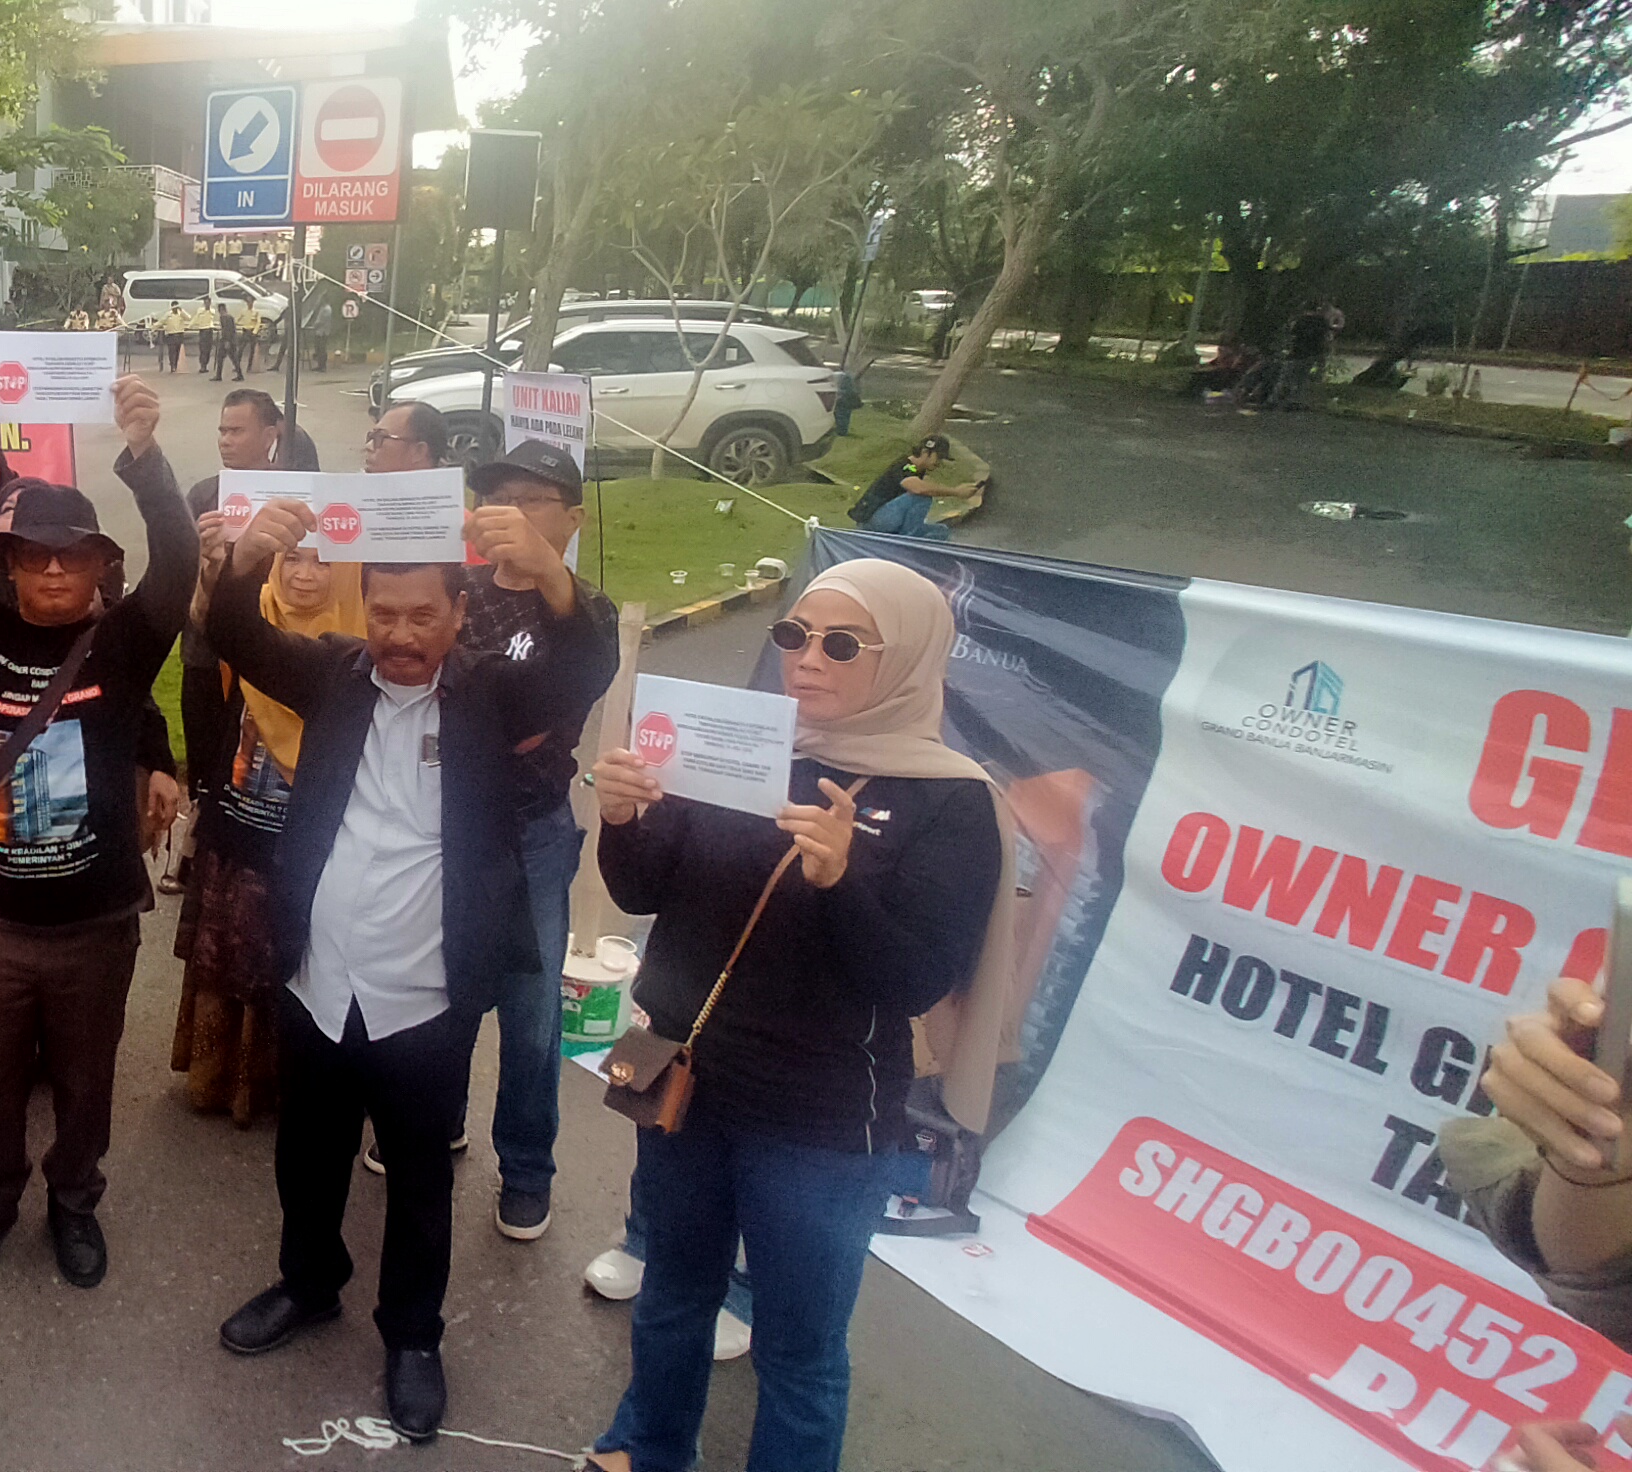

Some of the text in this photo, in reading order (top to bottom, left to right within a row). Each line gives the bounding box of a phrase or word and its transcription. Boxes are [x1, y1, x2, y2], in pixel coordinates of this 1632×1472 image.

[237, 190, 255, 208] IN
[302, 180, 389, 199] DILARANG
[314, 200, 374, 217] MASUK
[512, 385, 581, 417] UNIT KALIAN
[1241, 715, 1359, 752] CONDOTEL
[1259, 703, 1358, 736] OWNER
[1201, 721, 1394, 774] GRAND BANUA BANJARMASIN
[1161, 812, 1536, 997] OWNER
[1169, 934, 1391, 1076] HOTEL
[1118, 1139, 1578, 1413] SHGB00452
